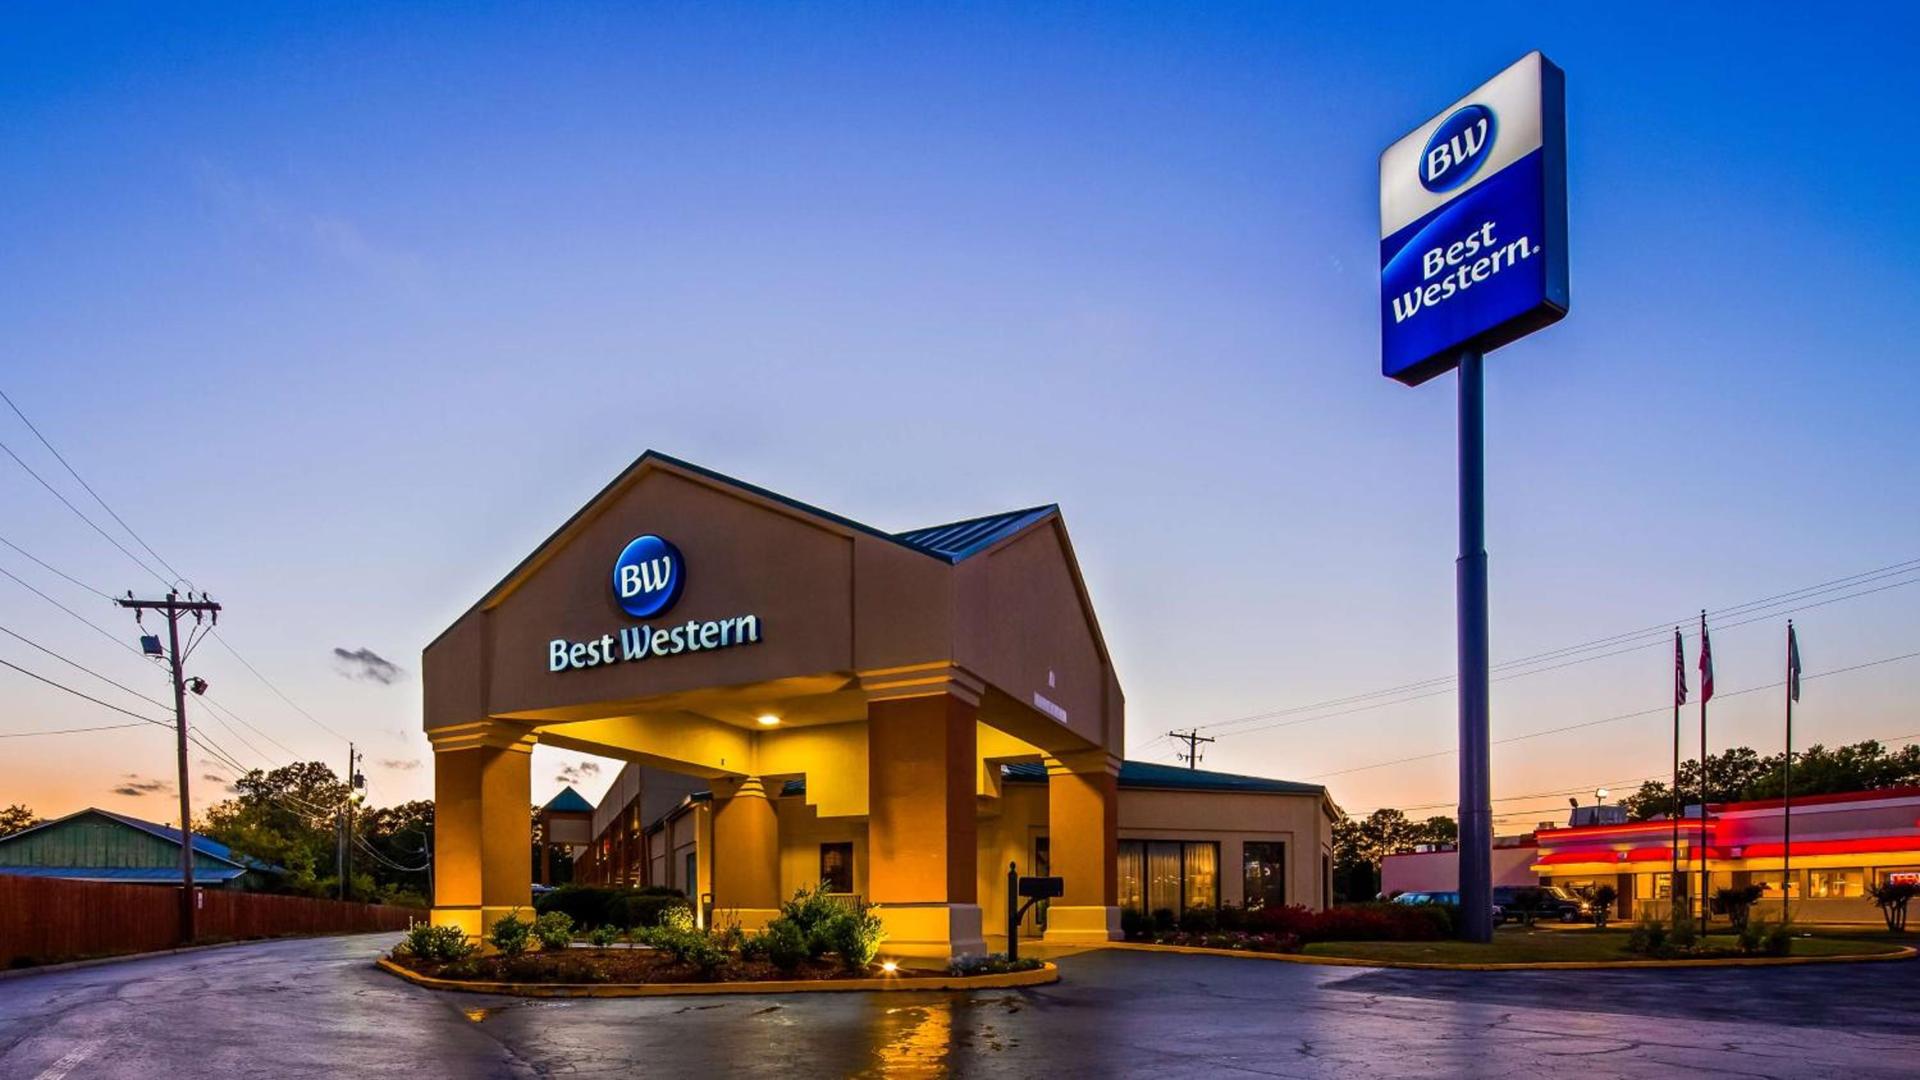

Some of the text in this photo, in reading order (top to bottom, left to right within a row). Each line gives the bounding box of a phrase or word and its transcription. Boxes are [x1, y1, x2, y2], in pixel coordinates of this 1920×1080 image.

[1427, 118, 1487, 181] BW
[1422, 221, 1496, 280] Best
[620, 556, 671, 598] BW
[549, 614, 760, 672] Best Western
